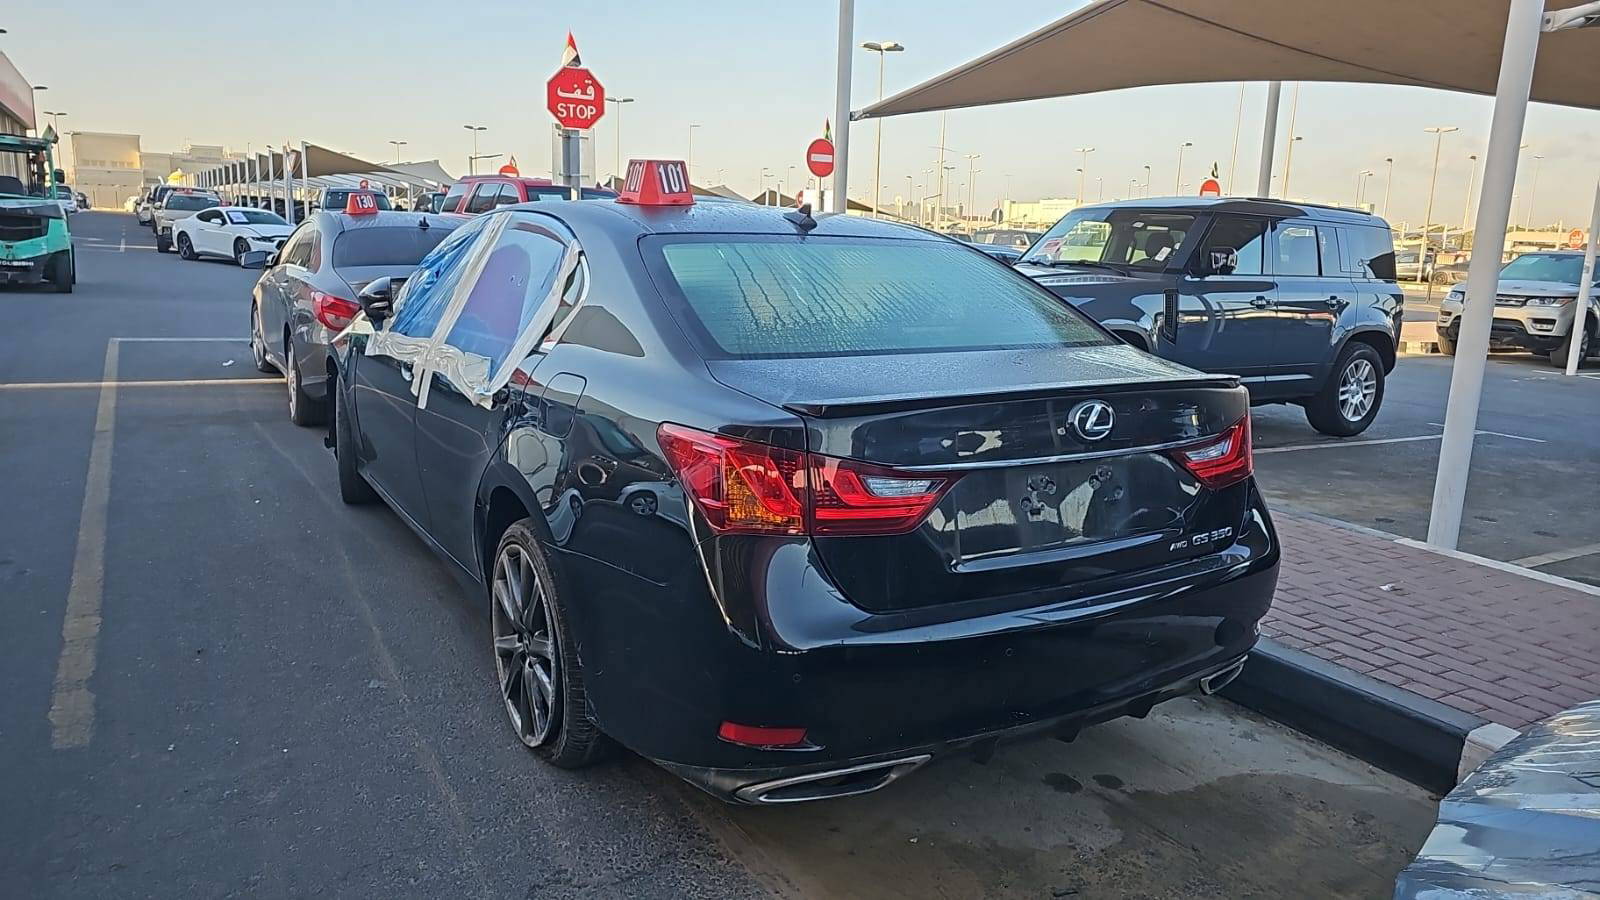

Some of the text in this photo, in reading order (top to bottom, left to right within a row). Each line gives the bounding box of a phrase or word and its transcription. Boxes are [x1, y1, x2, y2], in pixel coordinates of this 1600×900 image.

[557, 80, 595, 101] قف
[557, 103, 596, 119] STOP
[626, 163, 644, 192] 101
[659, 163, 687, 194] 101
[356, 195, 374, 208] 130
[1170, 527, 1232, 551] AWD GS 350
